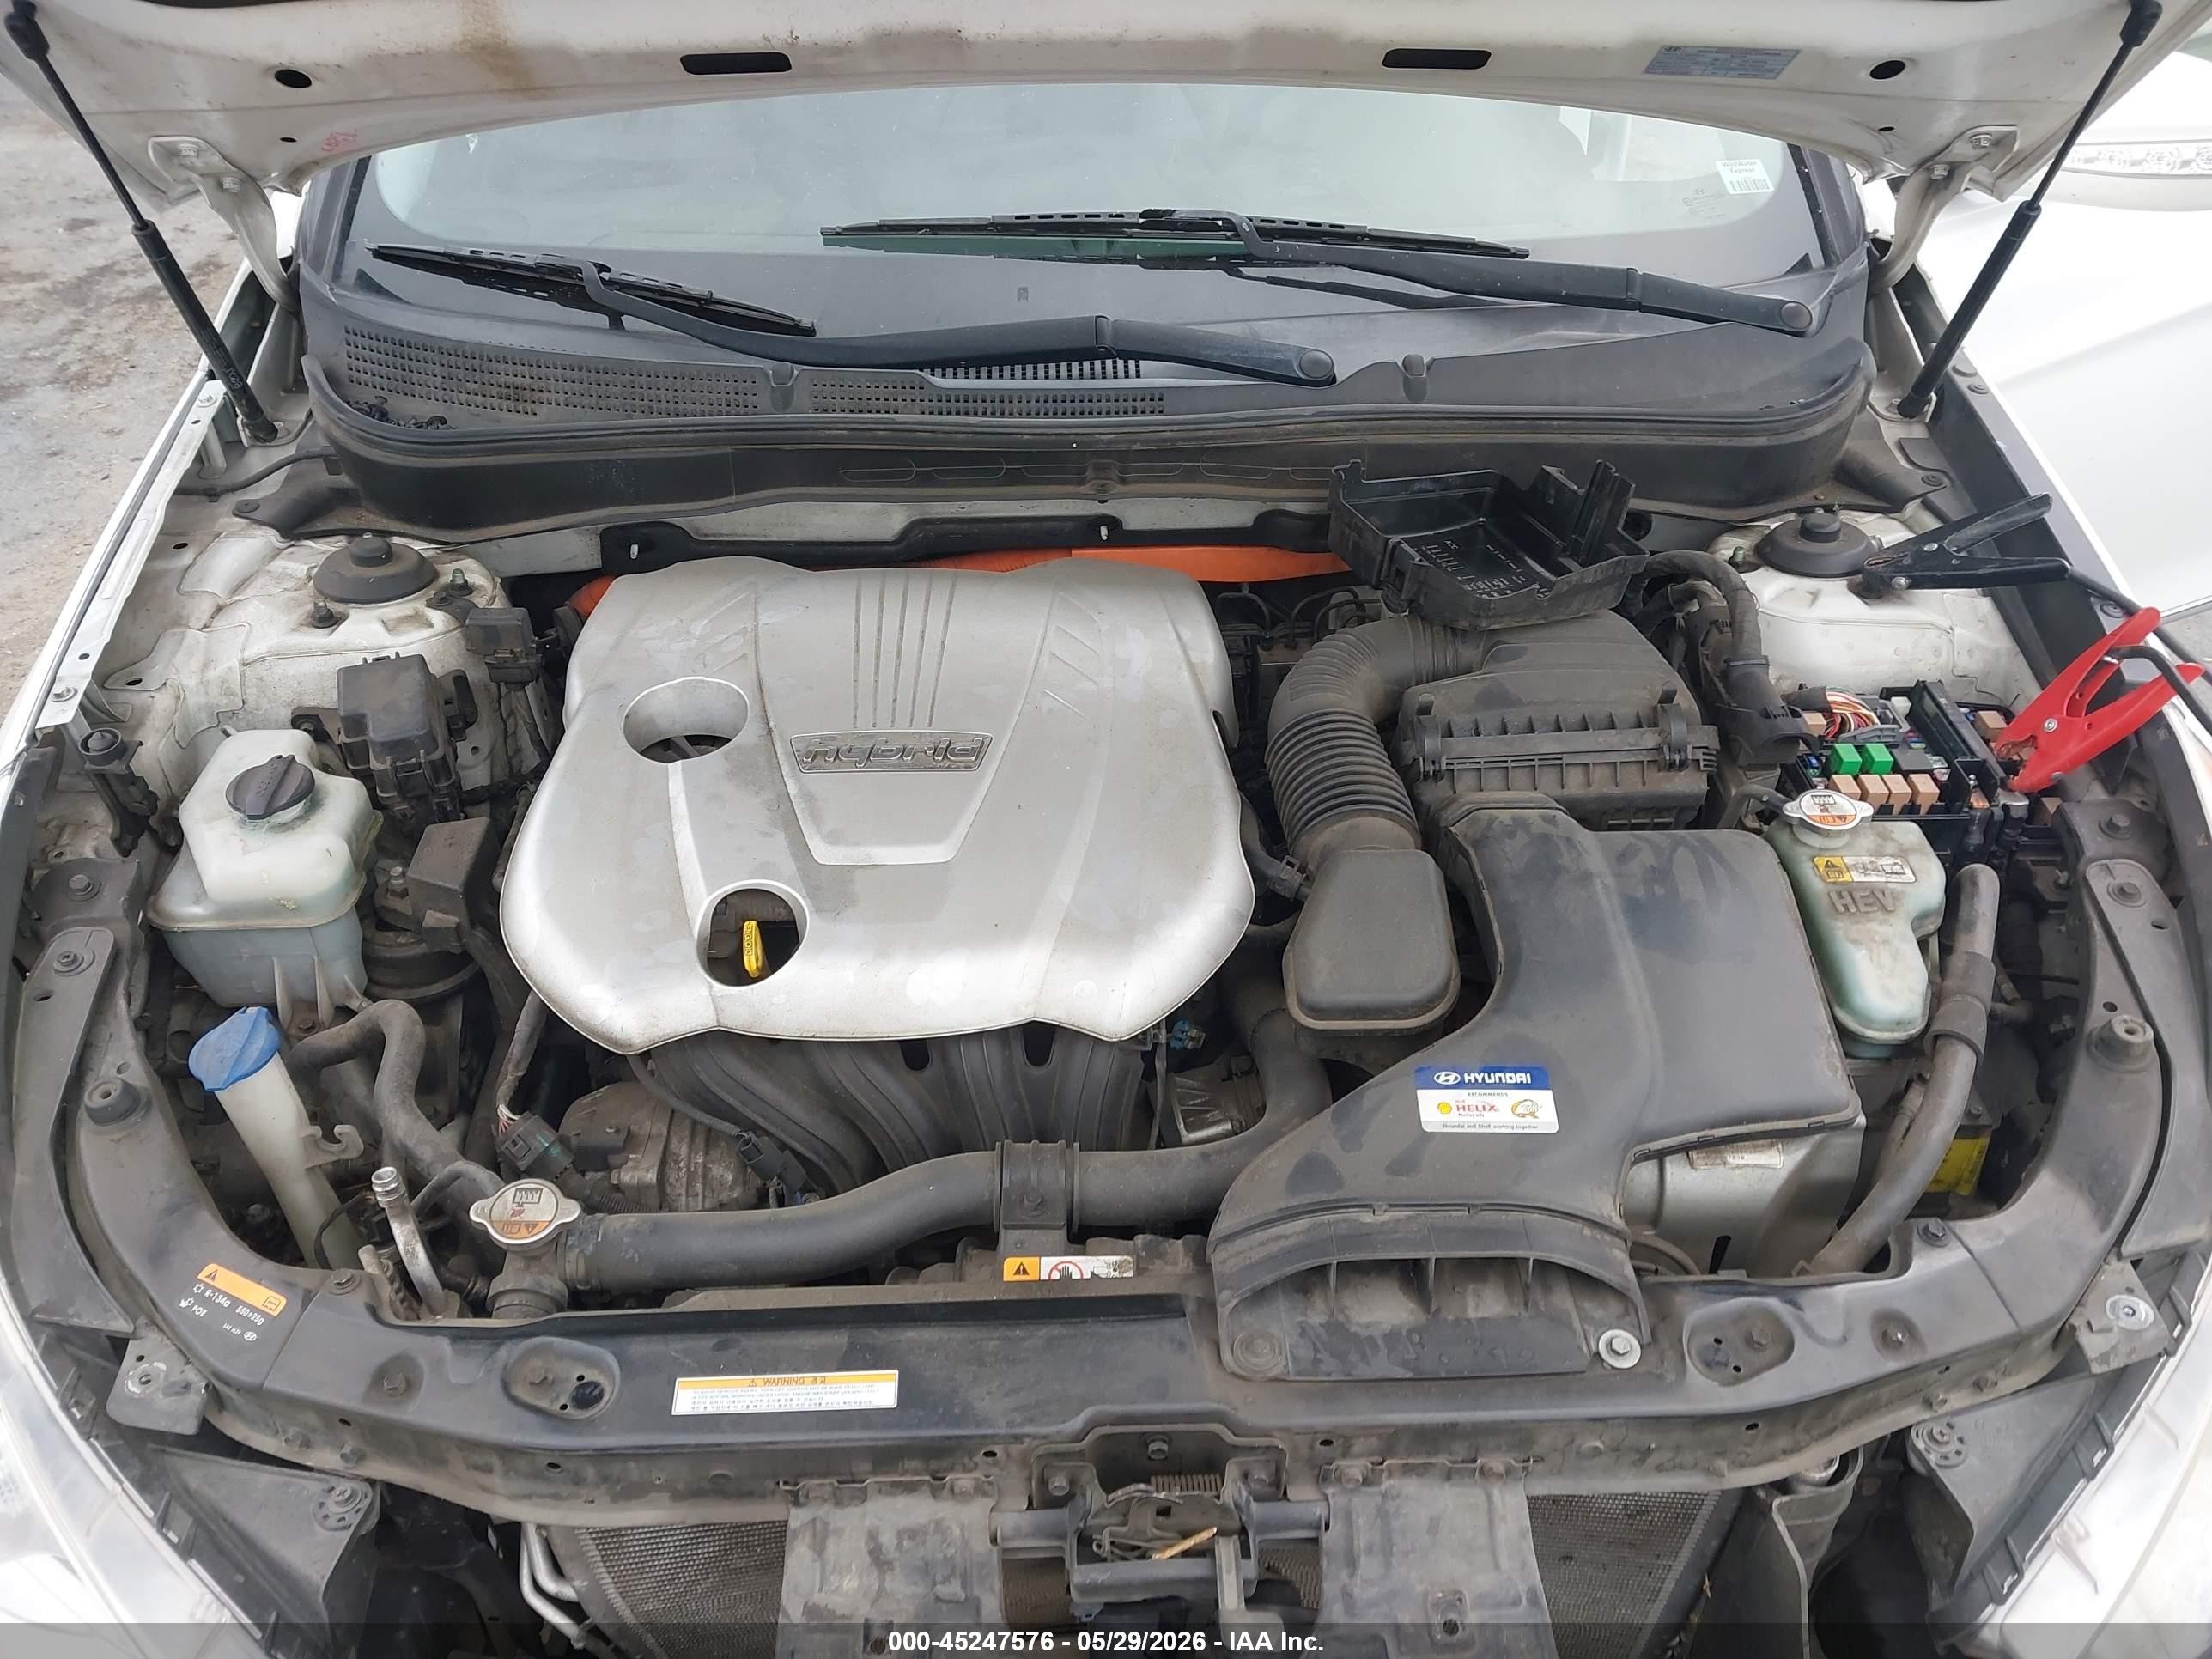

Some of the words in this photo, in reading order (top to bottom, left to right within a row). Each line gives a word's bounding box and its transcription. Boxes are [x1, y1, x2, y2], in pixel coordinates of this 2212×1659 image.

[1444, 540, 1459, 550] ACC
[803, 737, 985, 768] hybrid
[1828, 889, 1896, 914] HEV
[1464, 1073, 1532, 1084] HYUNDAI
[191, 1304, 208, 1317] POE
[763, 1377, 805, 1387] WARNING
